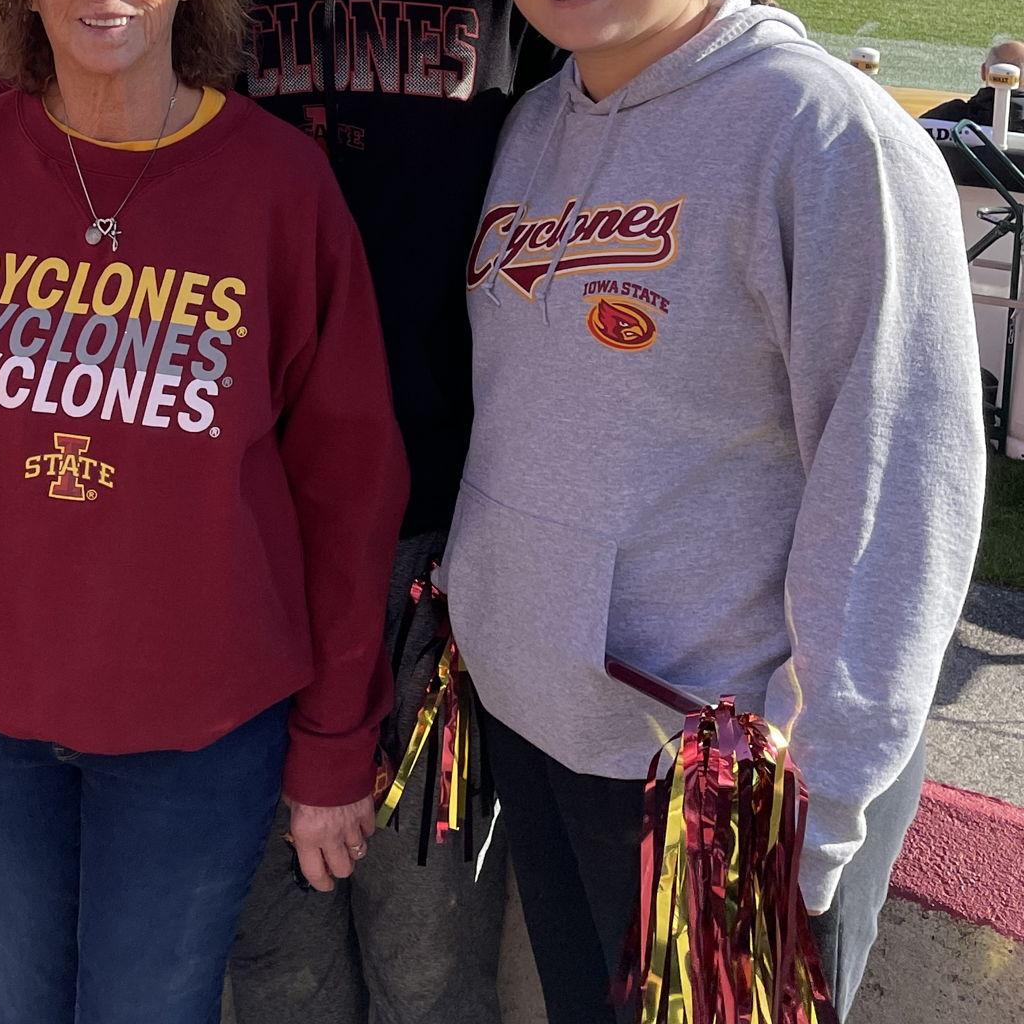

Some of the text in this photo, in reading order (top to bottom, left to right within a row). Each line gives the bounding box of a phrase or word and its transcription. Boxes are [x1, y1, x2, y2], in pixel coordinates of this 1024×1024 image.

[247, 0, 479, 102] CLONES
[466, 196, 686, 291] Cyclones
[582, 280, 671, 315] IOWA STATE
[25, 453, 114, 488] STATE
